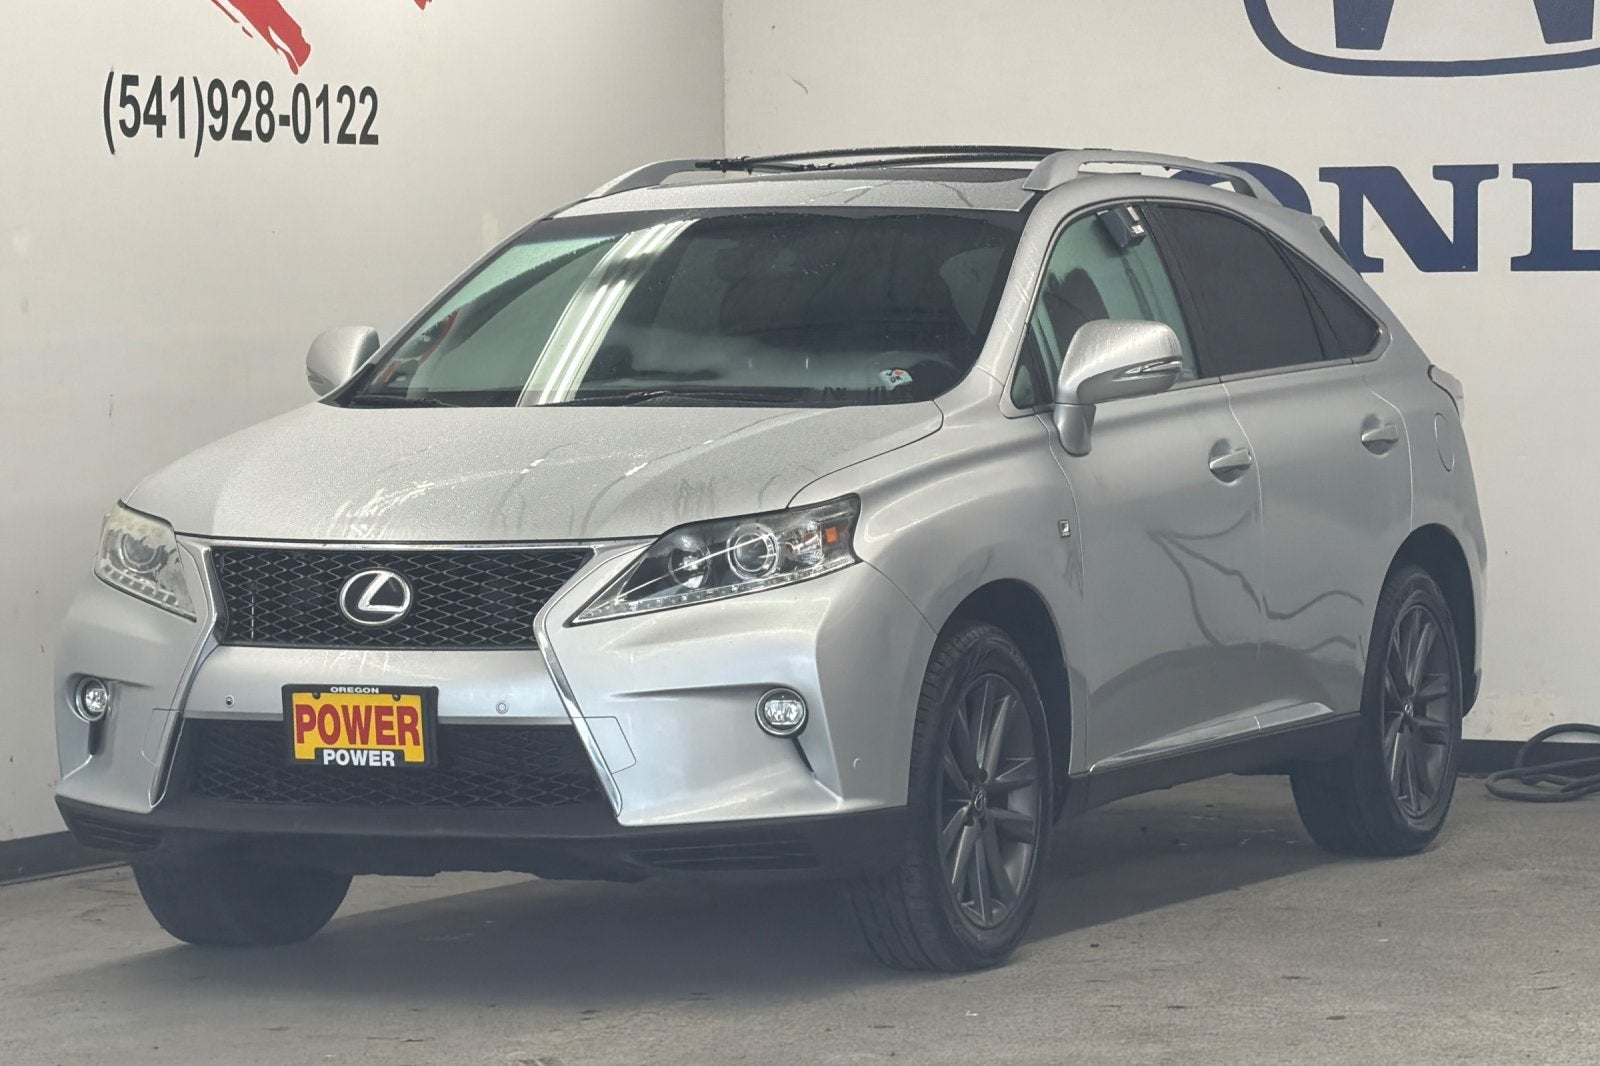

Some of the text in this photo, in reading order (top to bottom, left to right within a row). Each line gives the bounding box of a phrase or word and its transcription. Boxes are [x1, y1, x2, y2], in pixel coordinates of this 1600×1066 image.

[103, 70, 379, 157] (541)928-0122
[330, 686, 379, 694] OREGON
[295, 703, 421, 747] POWER
[323, 749, 395, 767] POWER
